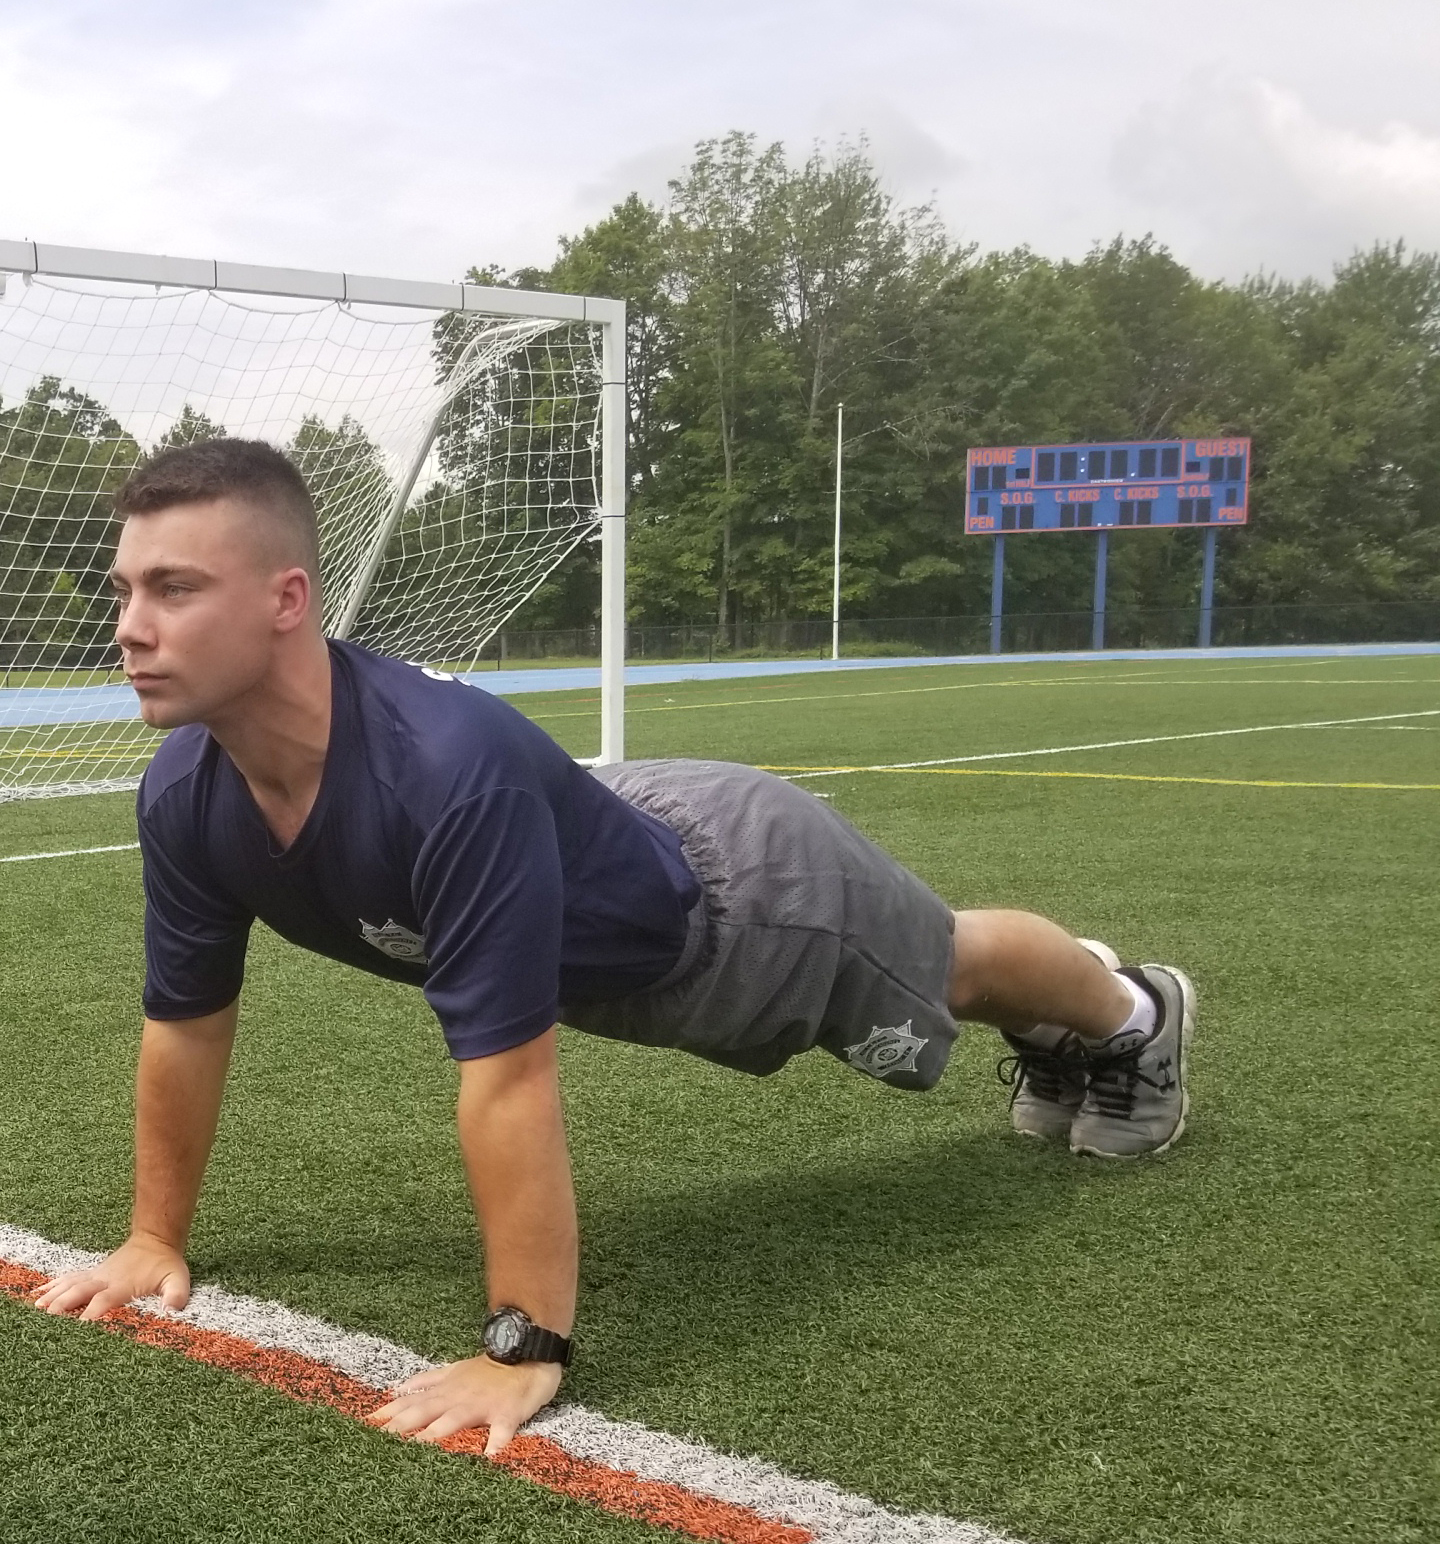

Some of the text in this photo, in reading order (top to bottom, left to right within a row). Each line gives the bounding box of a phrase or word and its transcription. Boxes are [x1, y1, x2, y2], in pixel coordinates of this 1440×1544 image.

[1196, 441, 1245, 457] GUEST
[971, 450, 1016, 465] HOME
[1000, 491, 1036, 505] S.O.G.
[1055, 489, 1100, 502] C. KICKS
[1114, 486, 1159, 500] C. KICKS
[1177, 485, 1214, 498] S.O.G.
[1218, 507, 1244, 520] PEN
[970, 516, 994, 529] PEN
